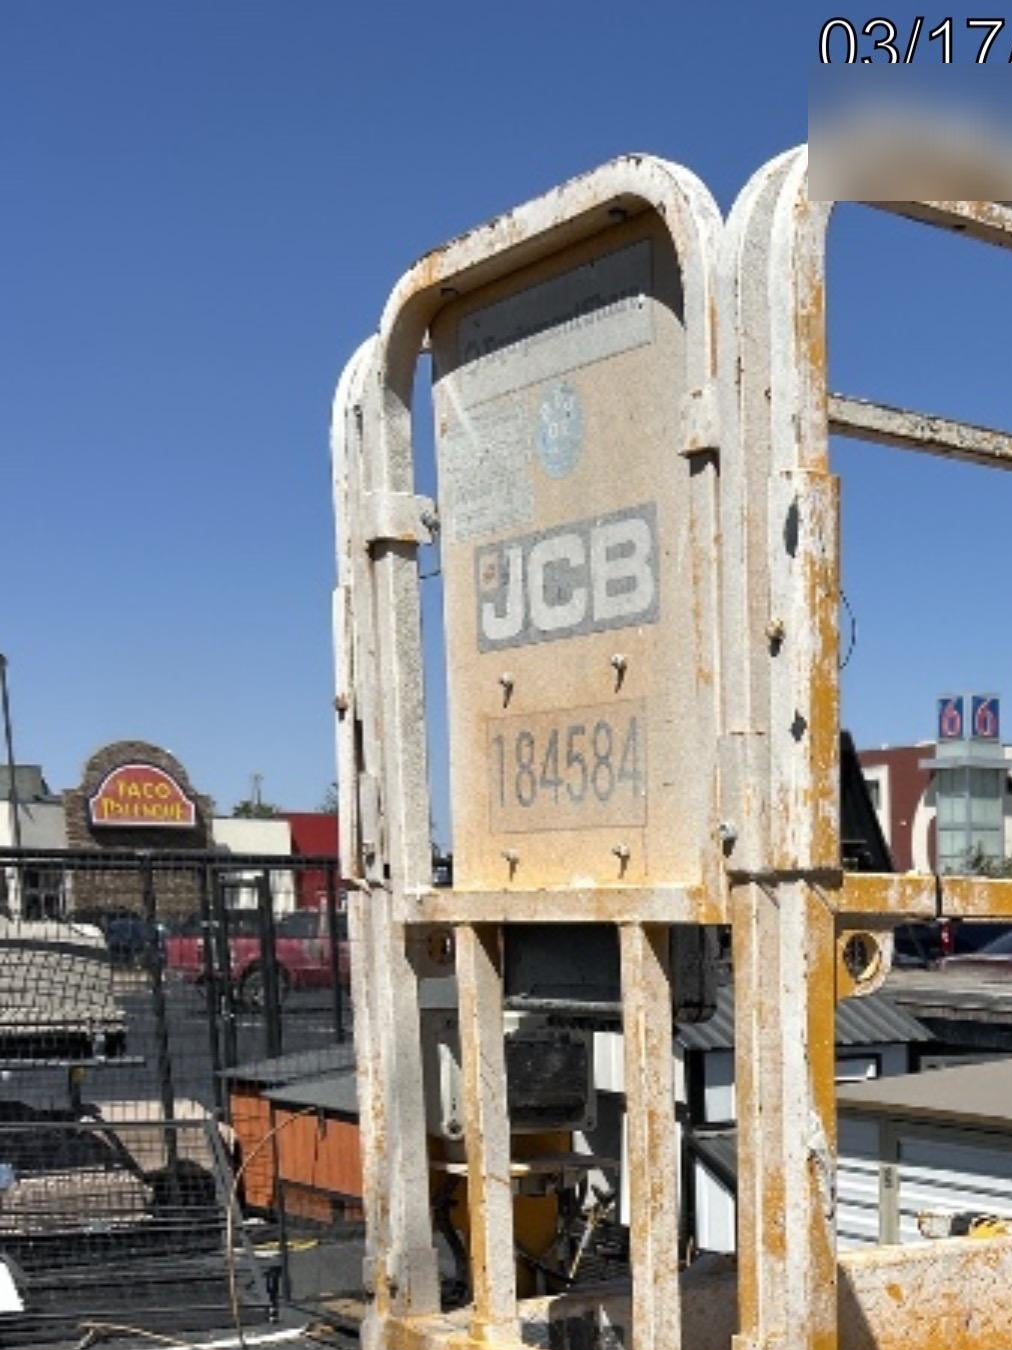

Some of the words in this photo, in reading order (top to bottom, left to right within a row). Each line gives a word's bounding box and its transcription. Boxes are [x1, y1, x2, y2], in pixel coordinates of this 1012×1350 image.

[480, 517, 656, 641] JCB
[976, 698, 997, 737] 6
[117, 779, 171, 799] TACO
[493, 716, 643, 808] 184584
